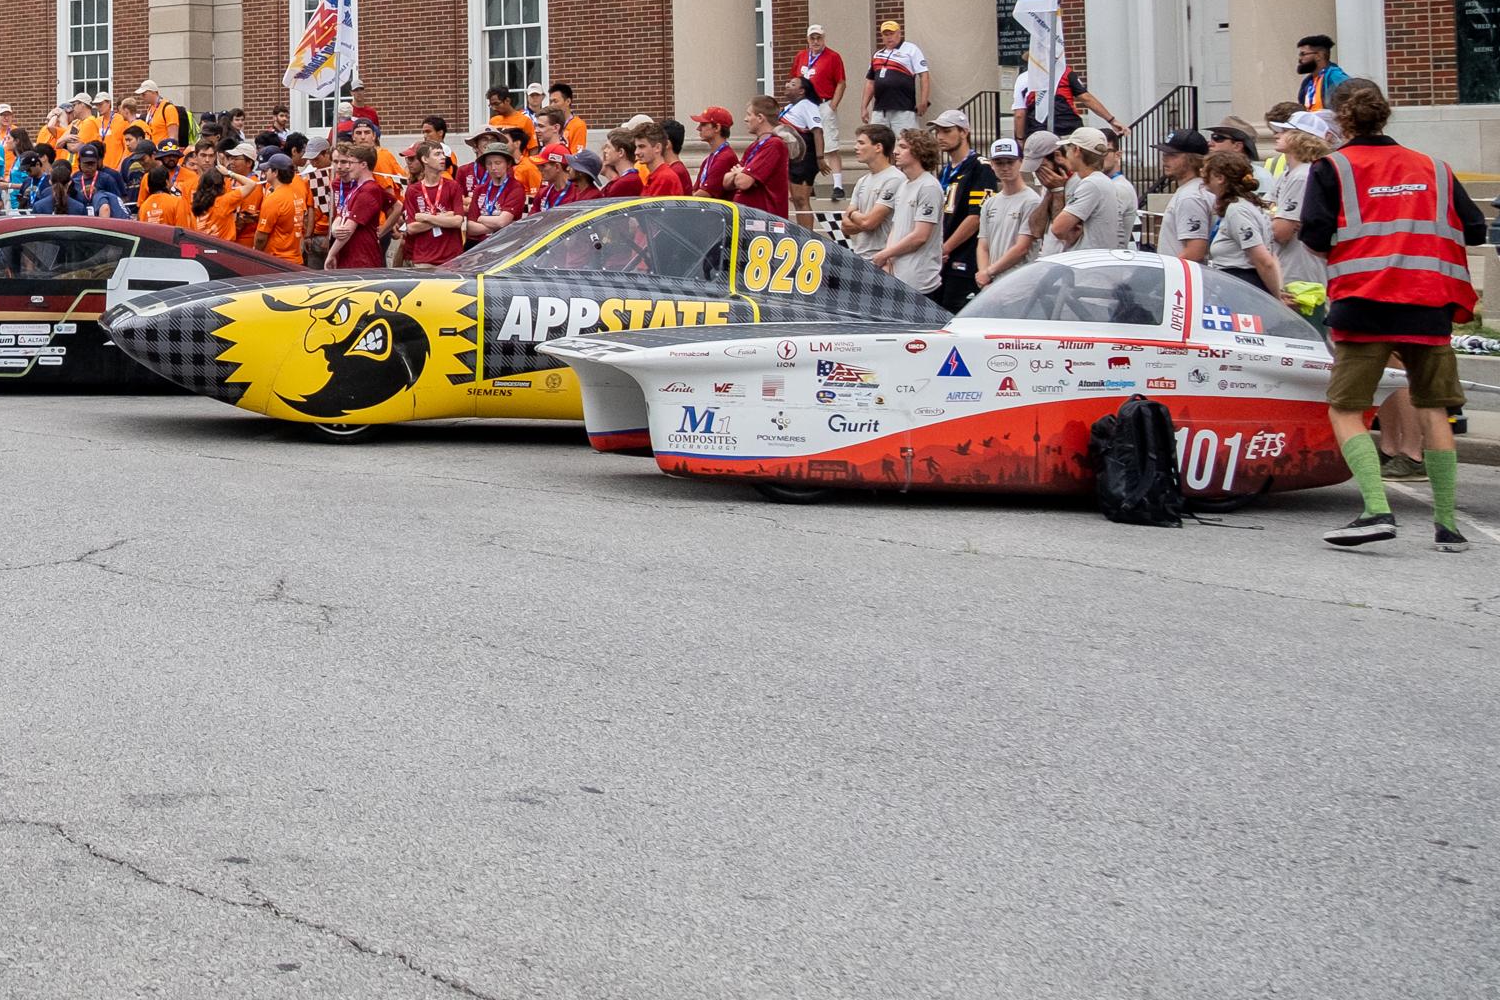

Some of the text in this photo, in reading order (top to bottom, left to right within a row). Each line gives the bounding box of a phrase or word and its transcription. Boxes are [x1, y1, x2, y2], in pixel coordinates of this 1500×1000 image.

[744, 236, 826, 295] 828
[1171, 304, 1184, 332] OPEN
[809, 342, 833, 352] LM
[1058, 340, 1095, 349] Altium
[1197, 348, 1233, 358] SKF
[1030, 359, 1054, 372] igus
[467, 388, 513, 397] SIEMENS
[658, 382, 695, 393] Linde
[714, 383, 734, 393] WE
[896, 385, 916, 393] CTA
[946, 391, 983, 400] AIRTECH
[828, 414, 880, 433] Gurit
[668, 434, 738, 445] COMPOSITES
